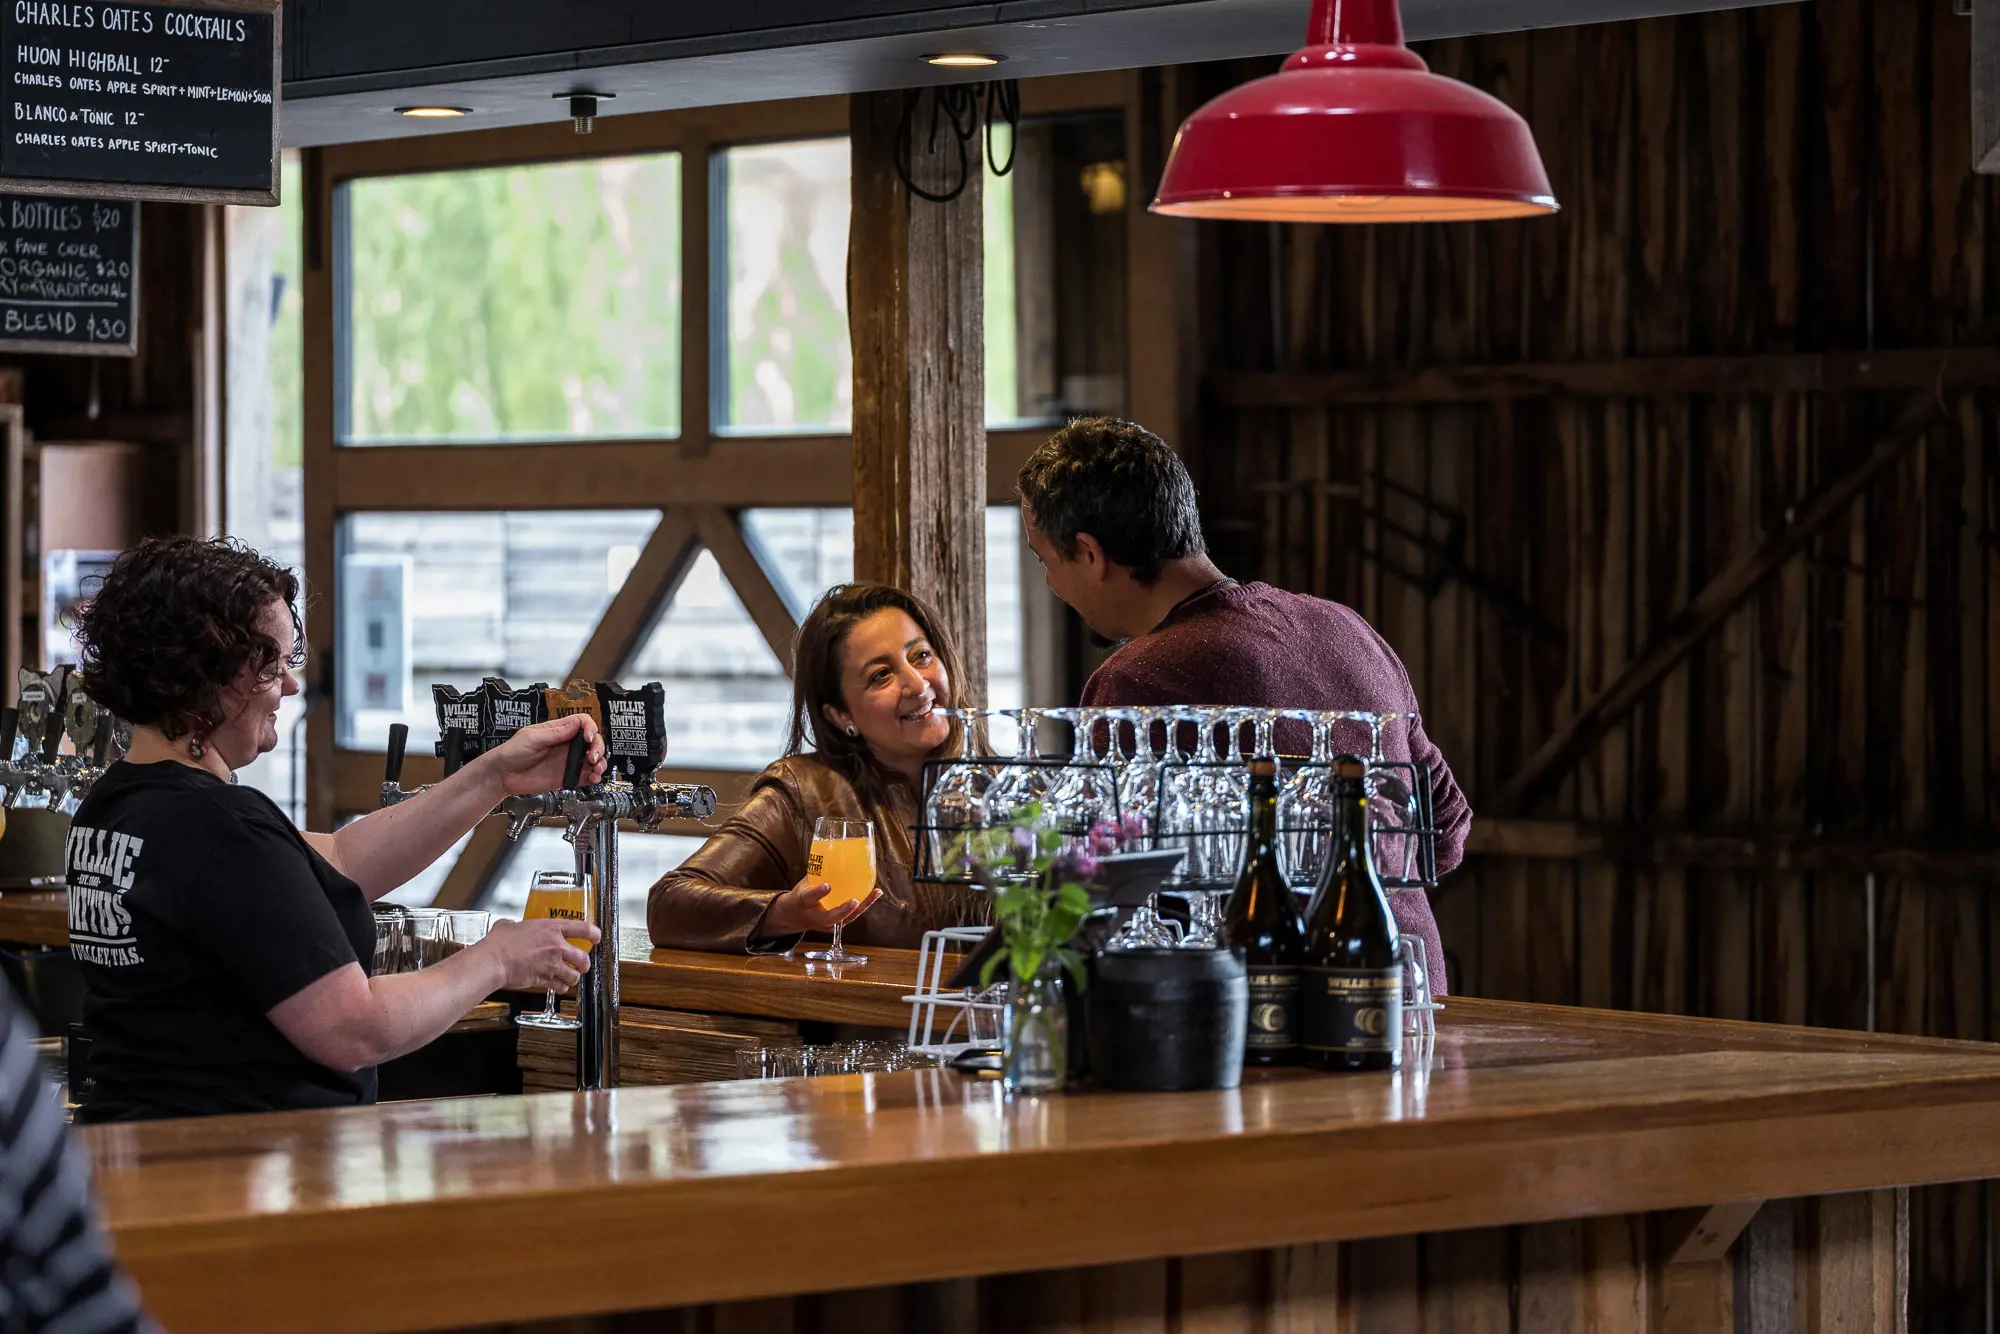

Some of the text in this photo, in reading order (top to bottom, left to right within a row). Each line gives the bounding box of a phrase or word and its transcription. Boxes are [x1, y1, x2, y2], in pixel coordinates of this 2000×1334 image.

[15, 0, 246, 42] CHARLES OATES COCKTAILS
[17, 44, 61, 66] HUON
[68, 49, 142, 75] HIGHBALL
[14, 72, 62, 88] CHARLES
[69, 77, 102, 92] OATES
[106, 80, 137, 94] APPLE
[14, 102, 67, 123] BLANCO
[79, 108, 114, 126] TONIC
[15, 132, 67, 147] CHARLES
[71, 136, 104, 149] OATES
[108, 138, 140, 152] APPLE
[12, 200, 81, 231] BOTTLES
[92, 203, 121, 233] $20
[15, 238, 48, 255] FAVE
[58, 242, 102, 259] CIDER
[97, 259, 130, 279] $20
[5, 309, 126, 341] BLEND $30
[443, 704, 479, 716] WILLIE
[494, 699, 531, 715] WILLIE
[608, 700, 646, 716] WILLIE
[549, 908, 585, 920] WILLIE
